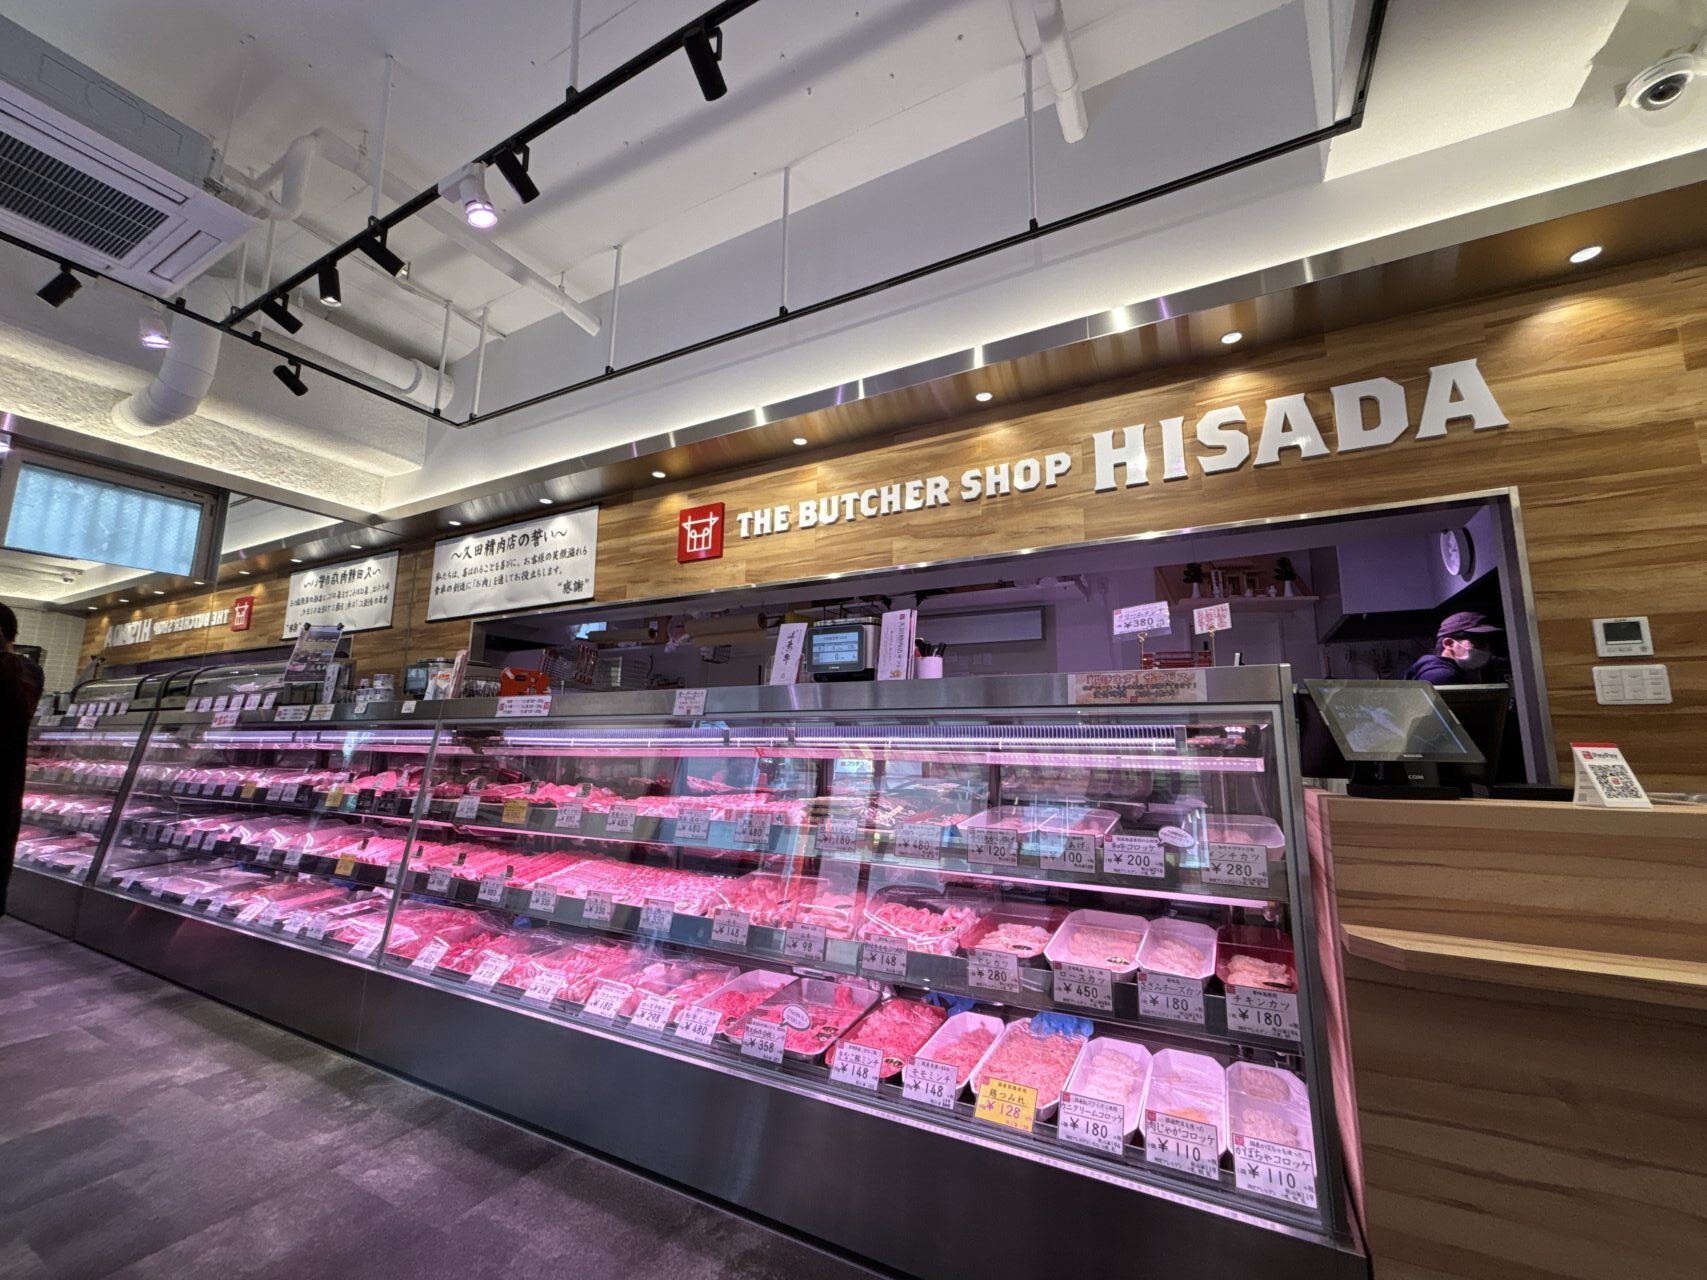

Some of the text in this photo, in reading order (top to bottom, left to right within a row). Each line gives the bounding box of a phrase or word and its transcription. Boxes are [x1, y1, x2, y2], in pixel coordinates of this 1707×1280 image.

[736, 358, 1510, 539] THE BUTCHER SHOP HISADA
[1113, 853, 1150, 867] ¥200
[1211, 862, 1252, 877] ¥280
[870, 952, 897, 967] ¥148
[976, 967, 1007, 982] ¥280
[1063, 982, 1098, 999] ¥450
[1149, 994, 1189, 1011] ¥180
[1238, 1007, 1282, 1028] ¥180
[749, 1037, 775, 1053] ¥358
[840, 1062, 869, 1079] ¥148
[912, 1079, 944, 1098] ¥148
[986, 1099, 1021, 1119] ¥128
[1069, 1116, 1108, 1139] ¥180
[1157, 1137, 1201, 1162] ¥110
[1236, 1145, 1311, 1172] かぼちゃコロッケ
[1247, 1162, 1296, 1189] ¥110
